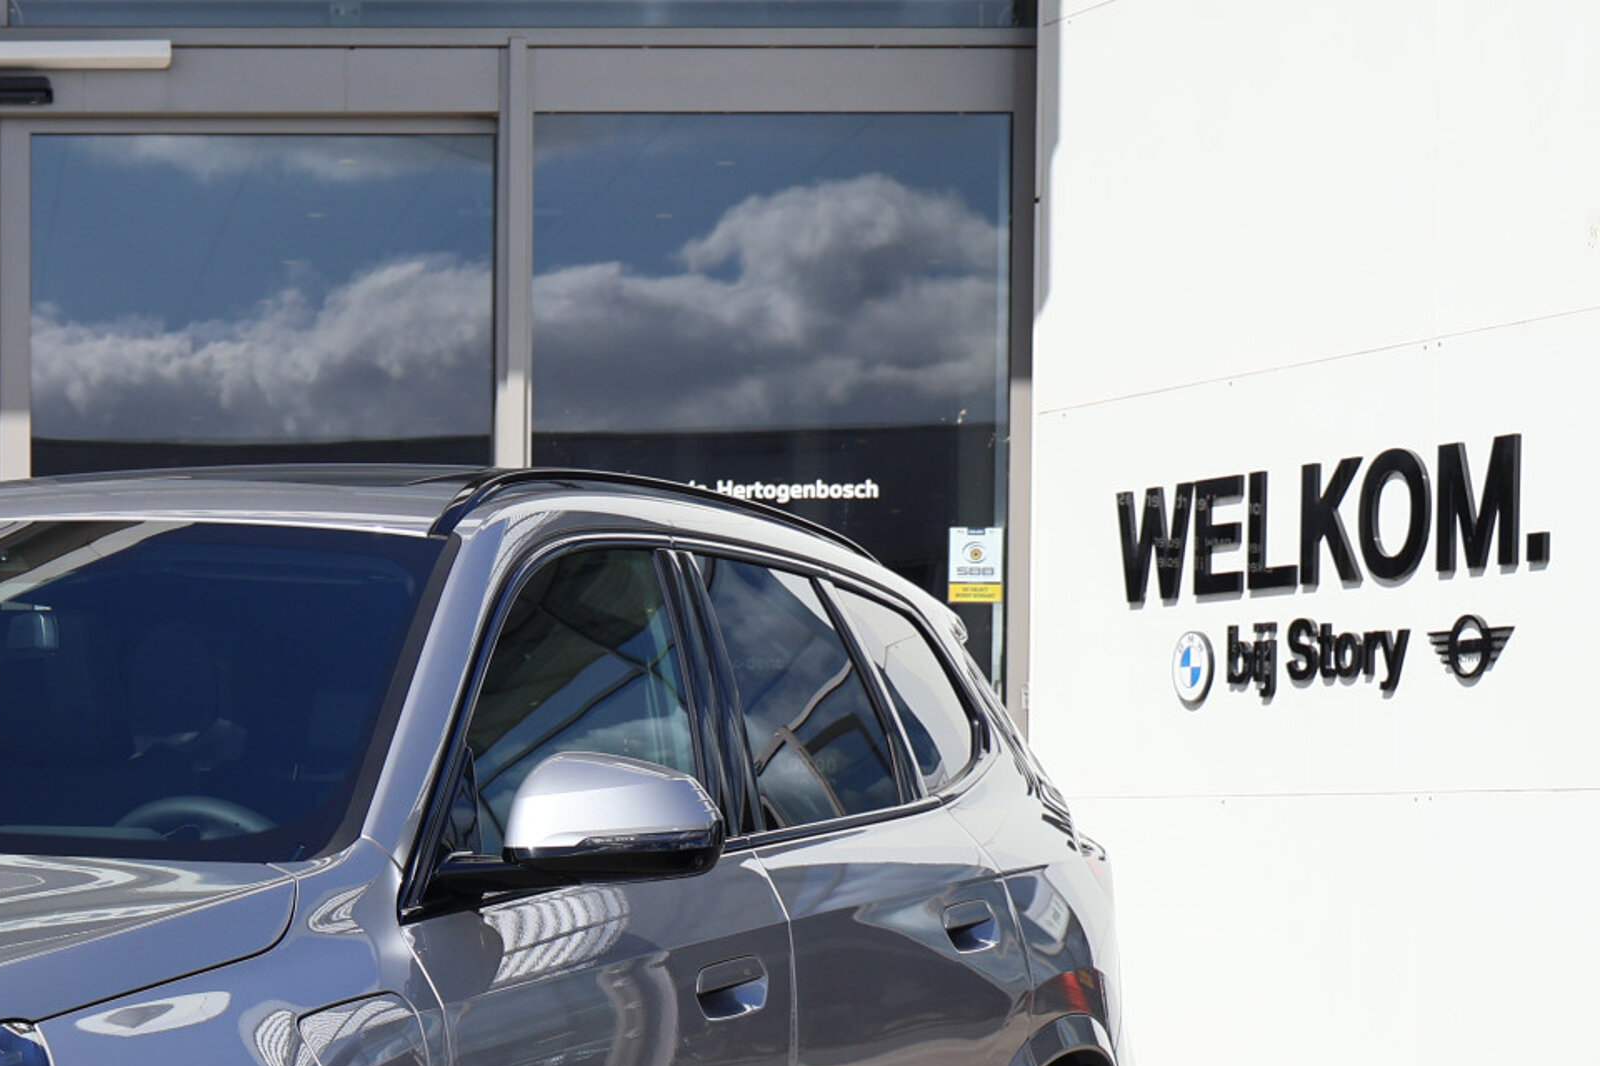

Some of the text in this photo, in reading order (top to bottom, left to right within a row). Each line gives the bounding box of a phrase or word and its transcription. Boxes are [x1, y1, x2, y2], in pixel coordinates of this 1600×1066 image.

[1116, 433, 1550, 605] WELKOM.
[1226, 617, 1410, 698] bij Story
